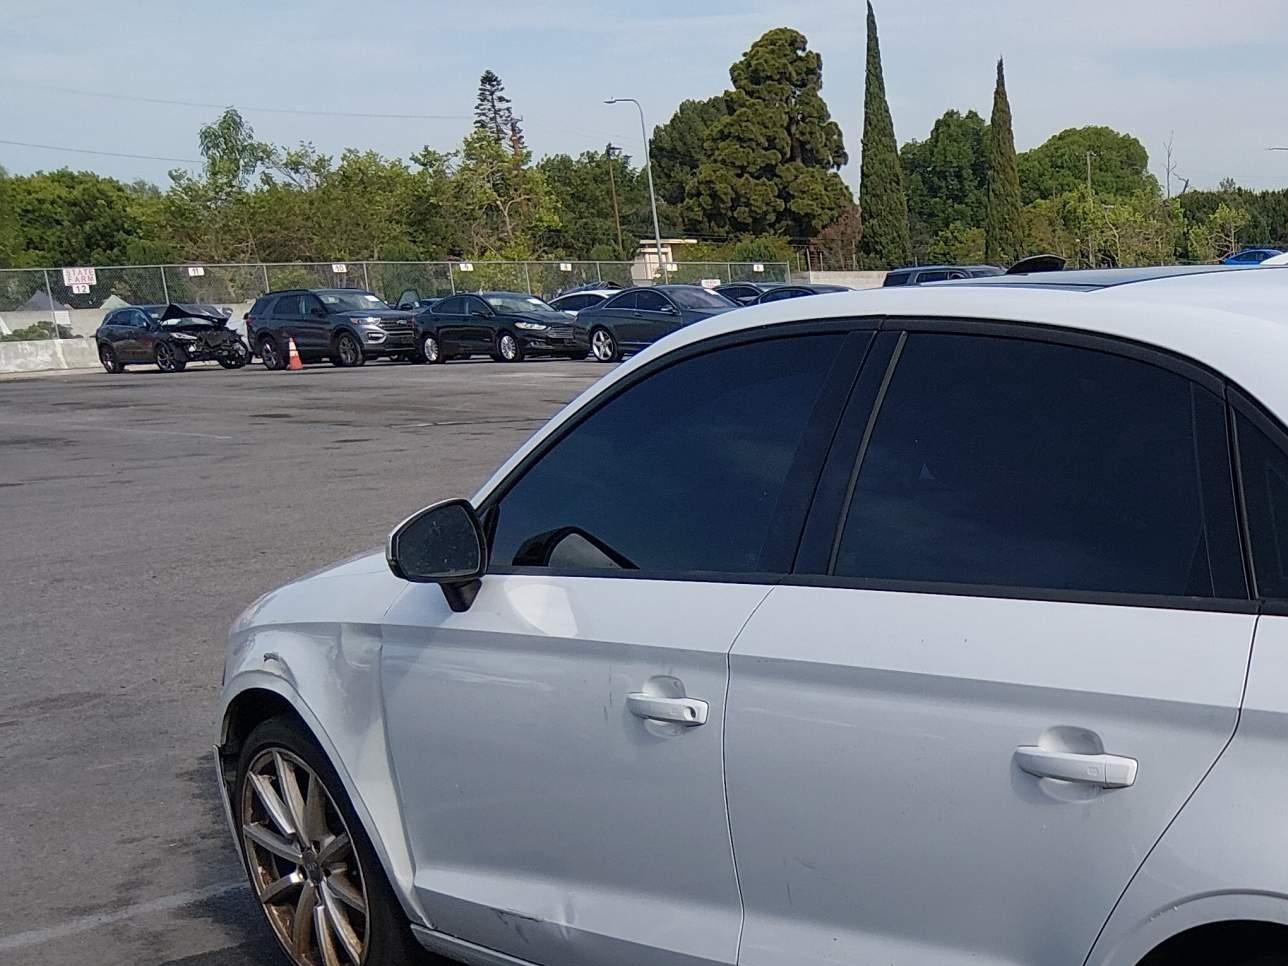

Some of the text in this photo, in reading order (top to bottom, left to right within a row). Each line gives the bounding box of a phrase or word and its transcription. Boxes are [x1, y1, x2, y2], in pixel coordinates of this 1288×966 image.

[334, 264, 345, 272] 10
[65, 269, 95, 277] STATE
[67, 275, 95, 283] FARM
[75, 285, 87, 293] 12
